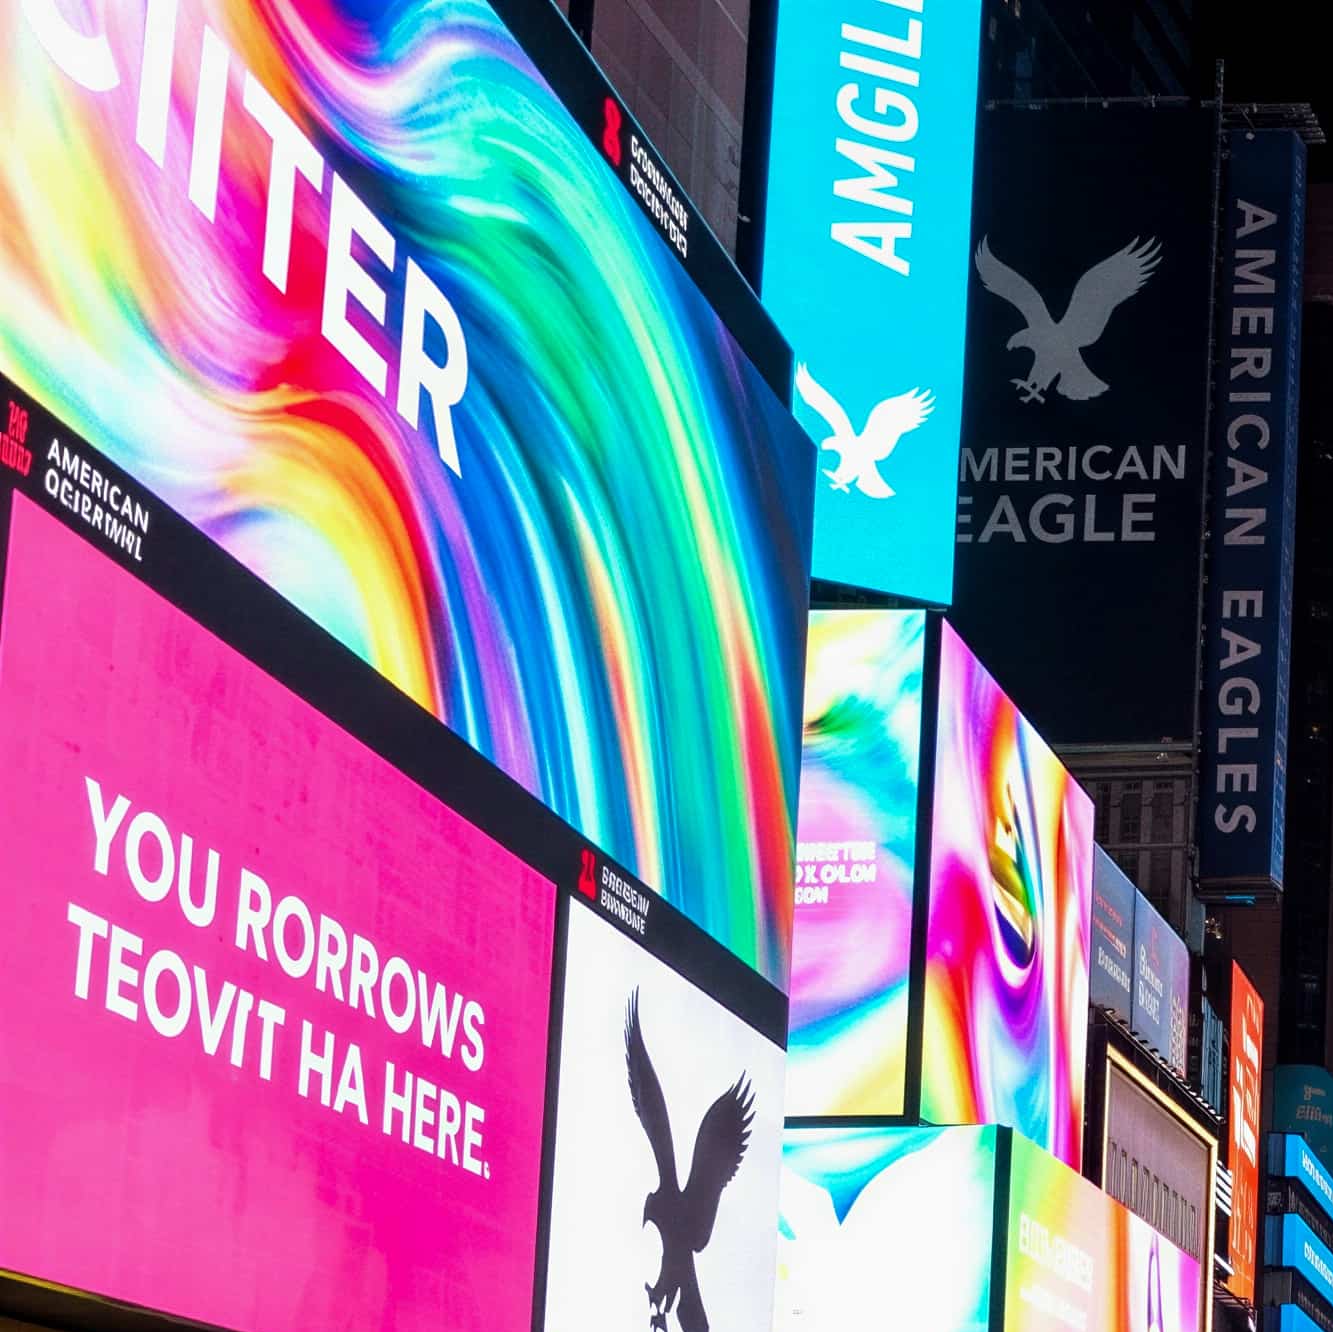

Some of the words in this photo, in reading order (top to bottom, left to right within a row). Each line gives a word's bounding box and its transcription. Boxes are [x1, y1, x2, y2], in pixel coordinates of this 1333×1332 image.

[831, 0, 924, 277] AMGIL
[47, 437, 150, 534] AMERICAN
[959, 444, 1187, 482] MERICAN
[1224, 199, 1278, 547] AMERICAN
[1213, 589, 1265, 835] EAGLES
[84, 774, 220, 929] YOU
[234, 867, 486, 1073] RORROWS
[297, 1018, 369, 1126] HA
